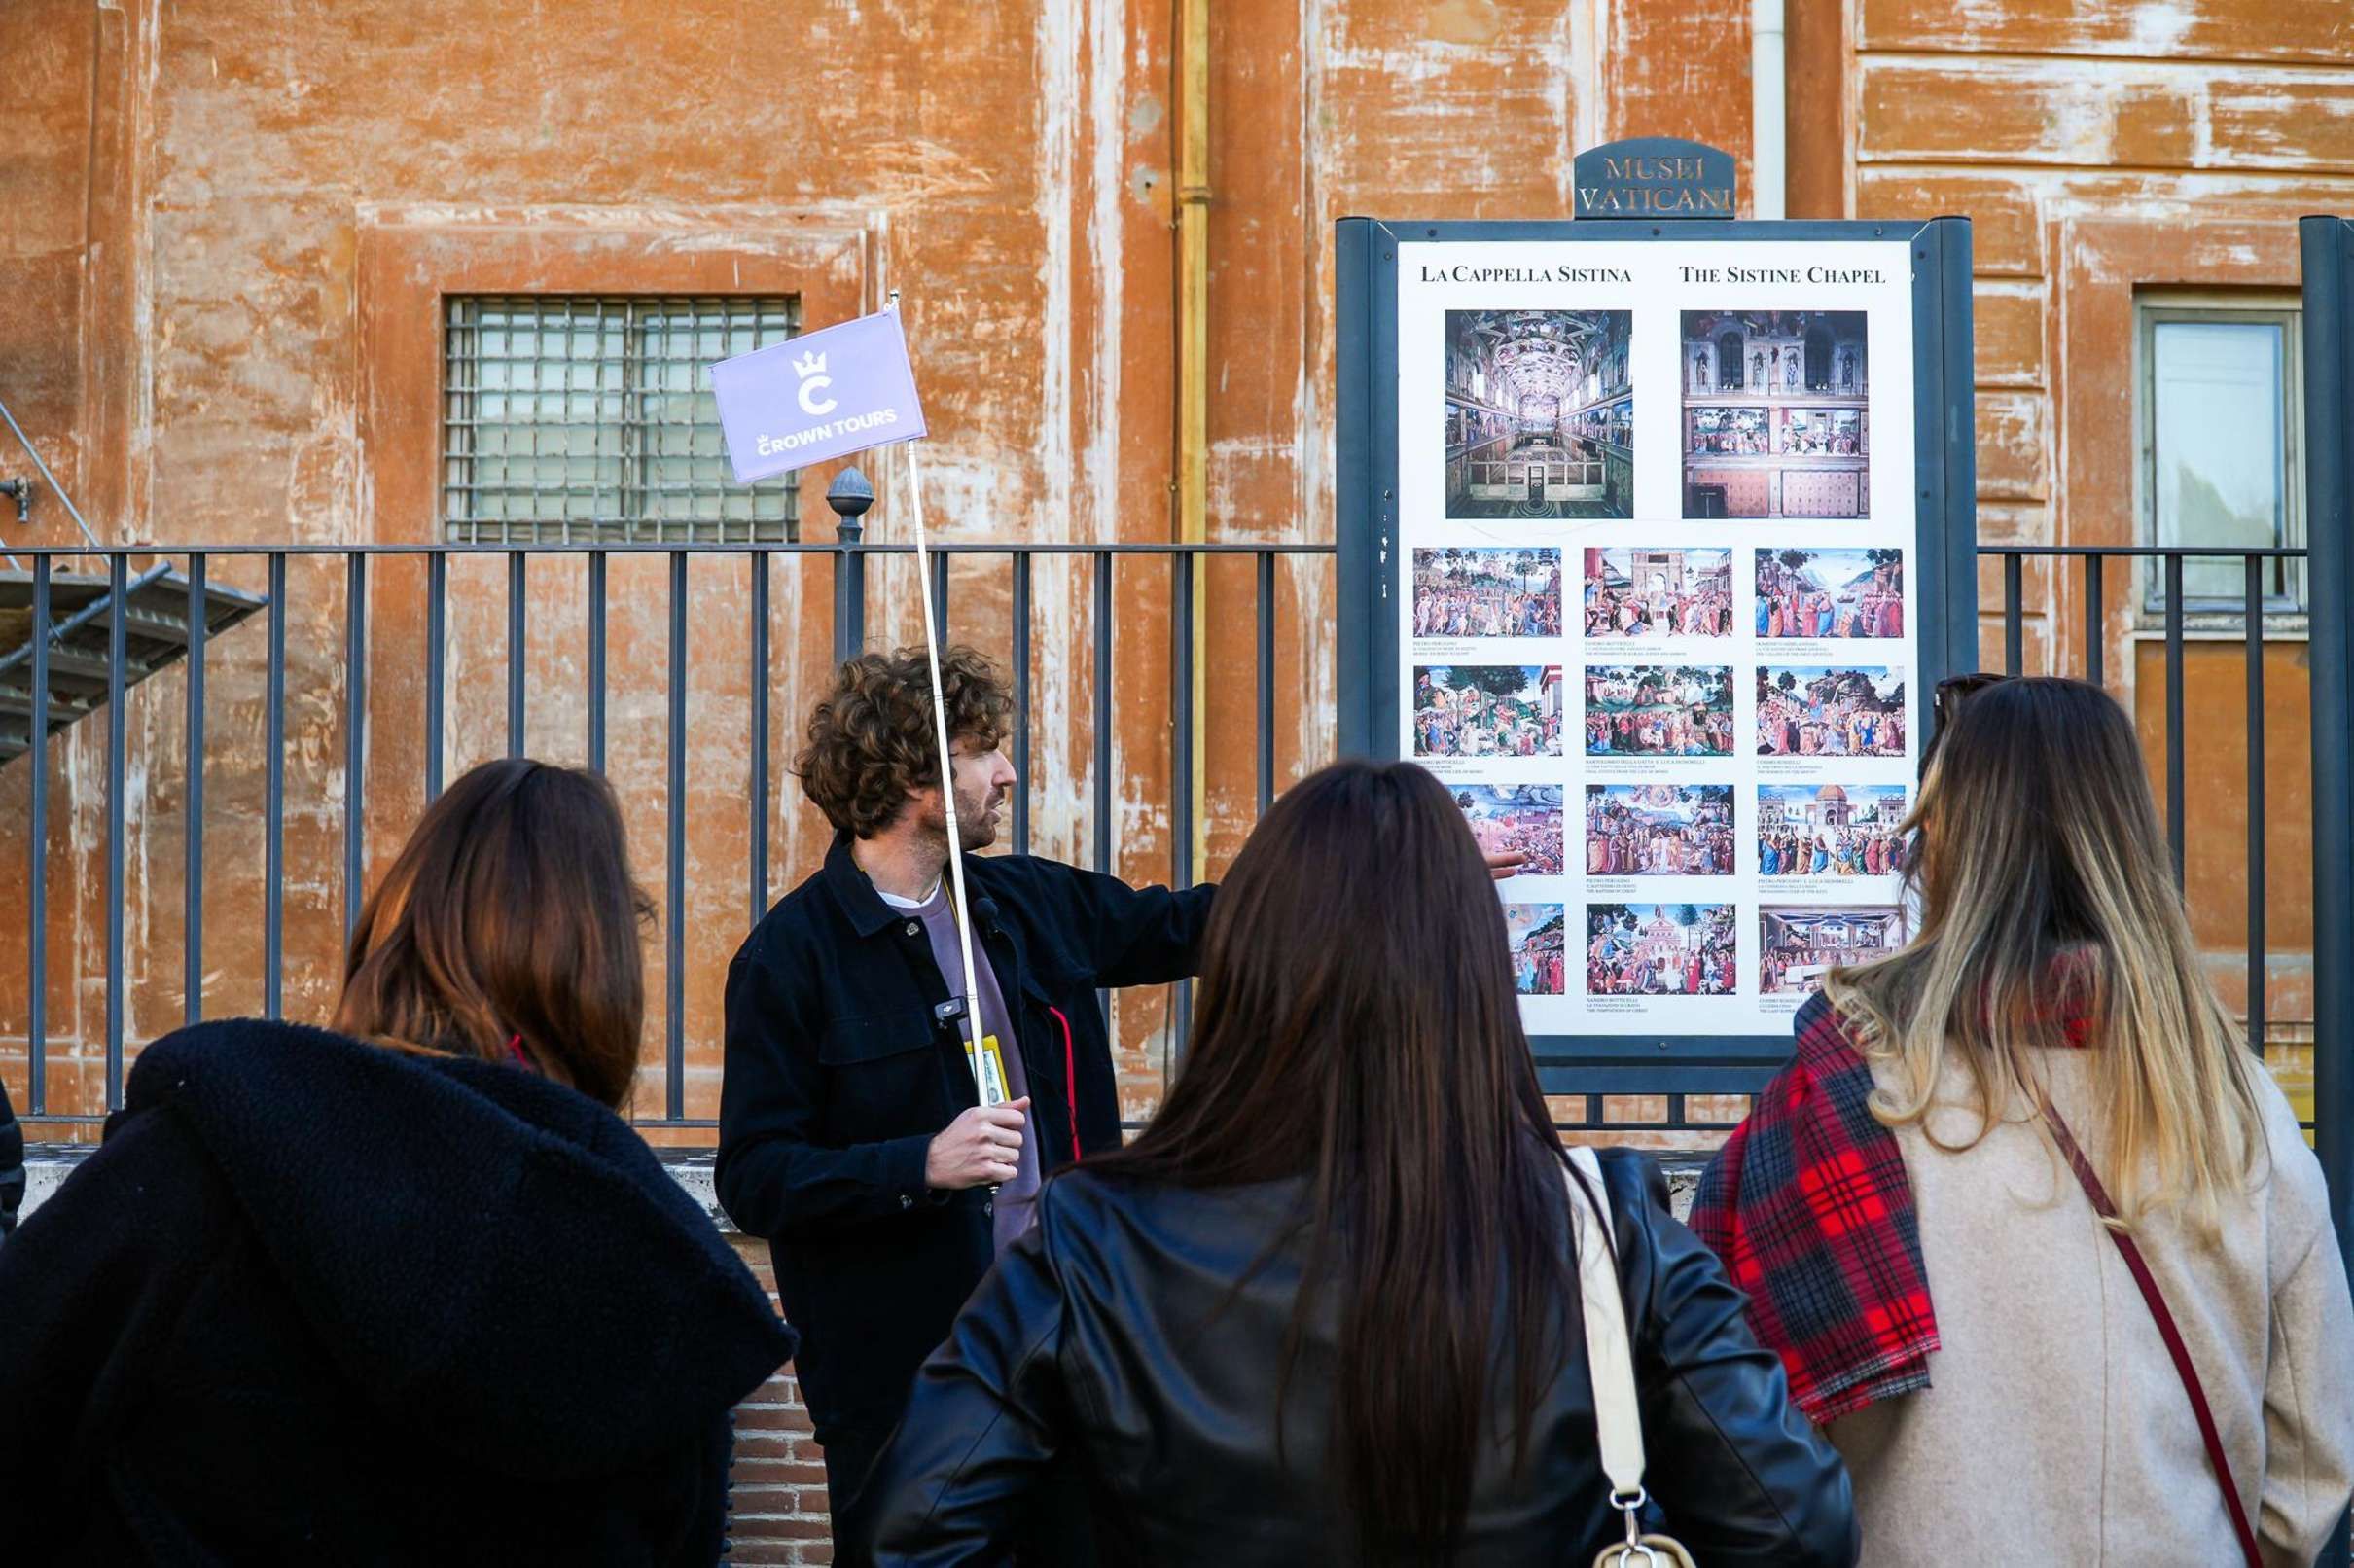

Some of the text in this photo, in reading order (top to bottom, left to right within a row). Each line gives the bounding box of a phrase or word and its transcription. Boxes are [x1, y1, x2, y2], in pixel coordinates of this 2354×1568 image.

[1605, 157, 1704, 180] MUSEI
[1579, 188, 1730, 211] VATICANI
[1452, 266, 1552, 283] CAPPELLA
[1558, 266, 1631, 283] SISTINA
[1679, 266, 1886, 284] THE SISTINE CHAPEL
[757, 408, 898, 456] CROWN TOURS
